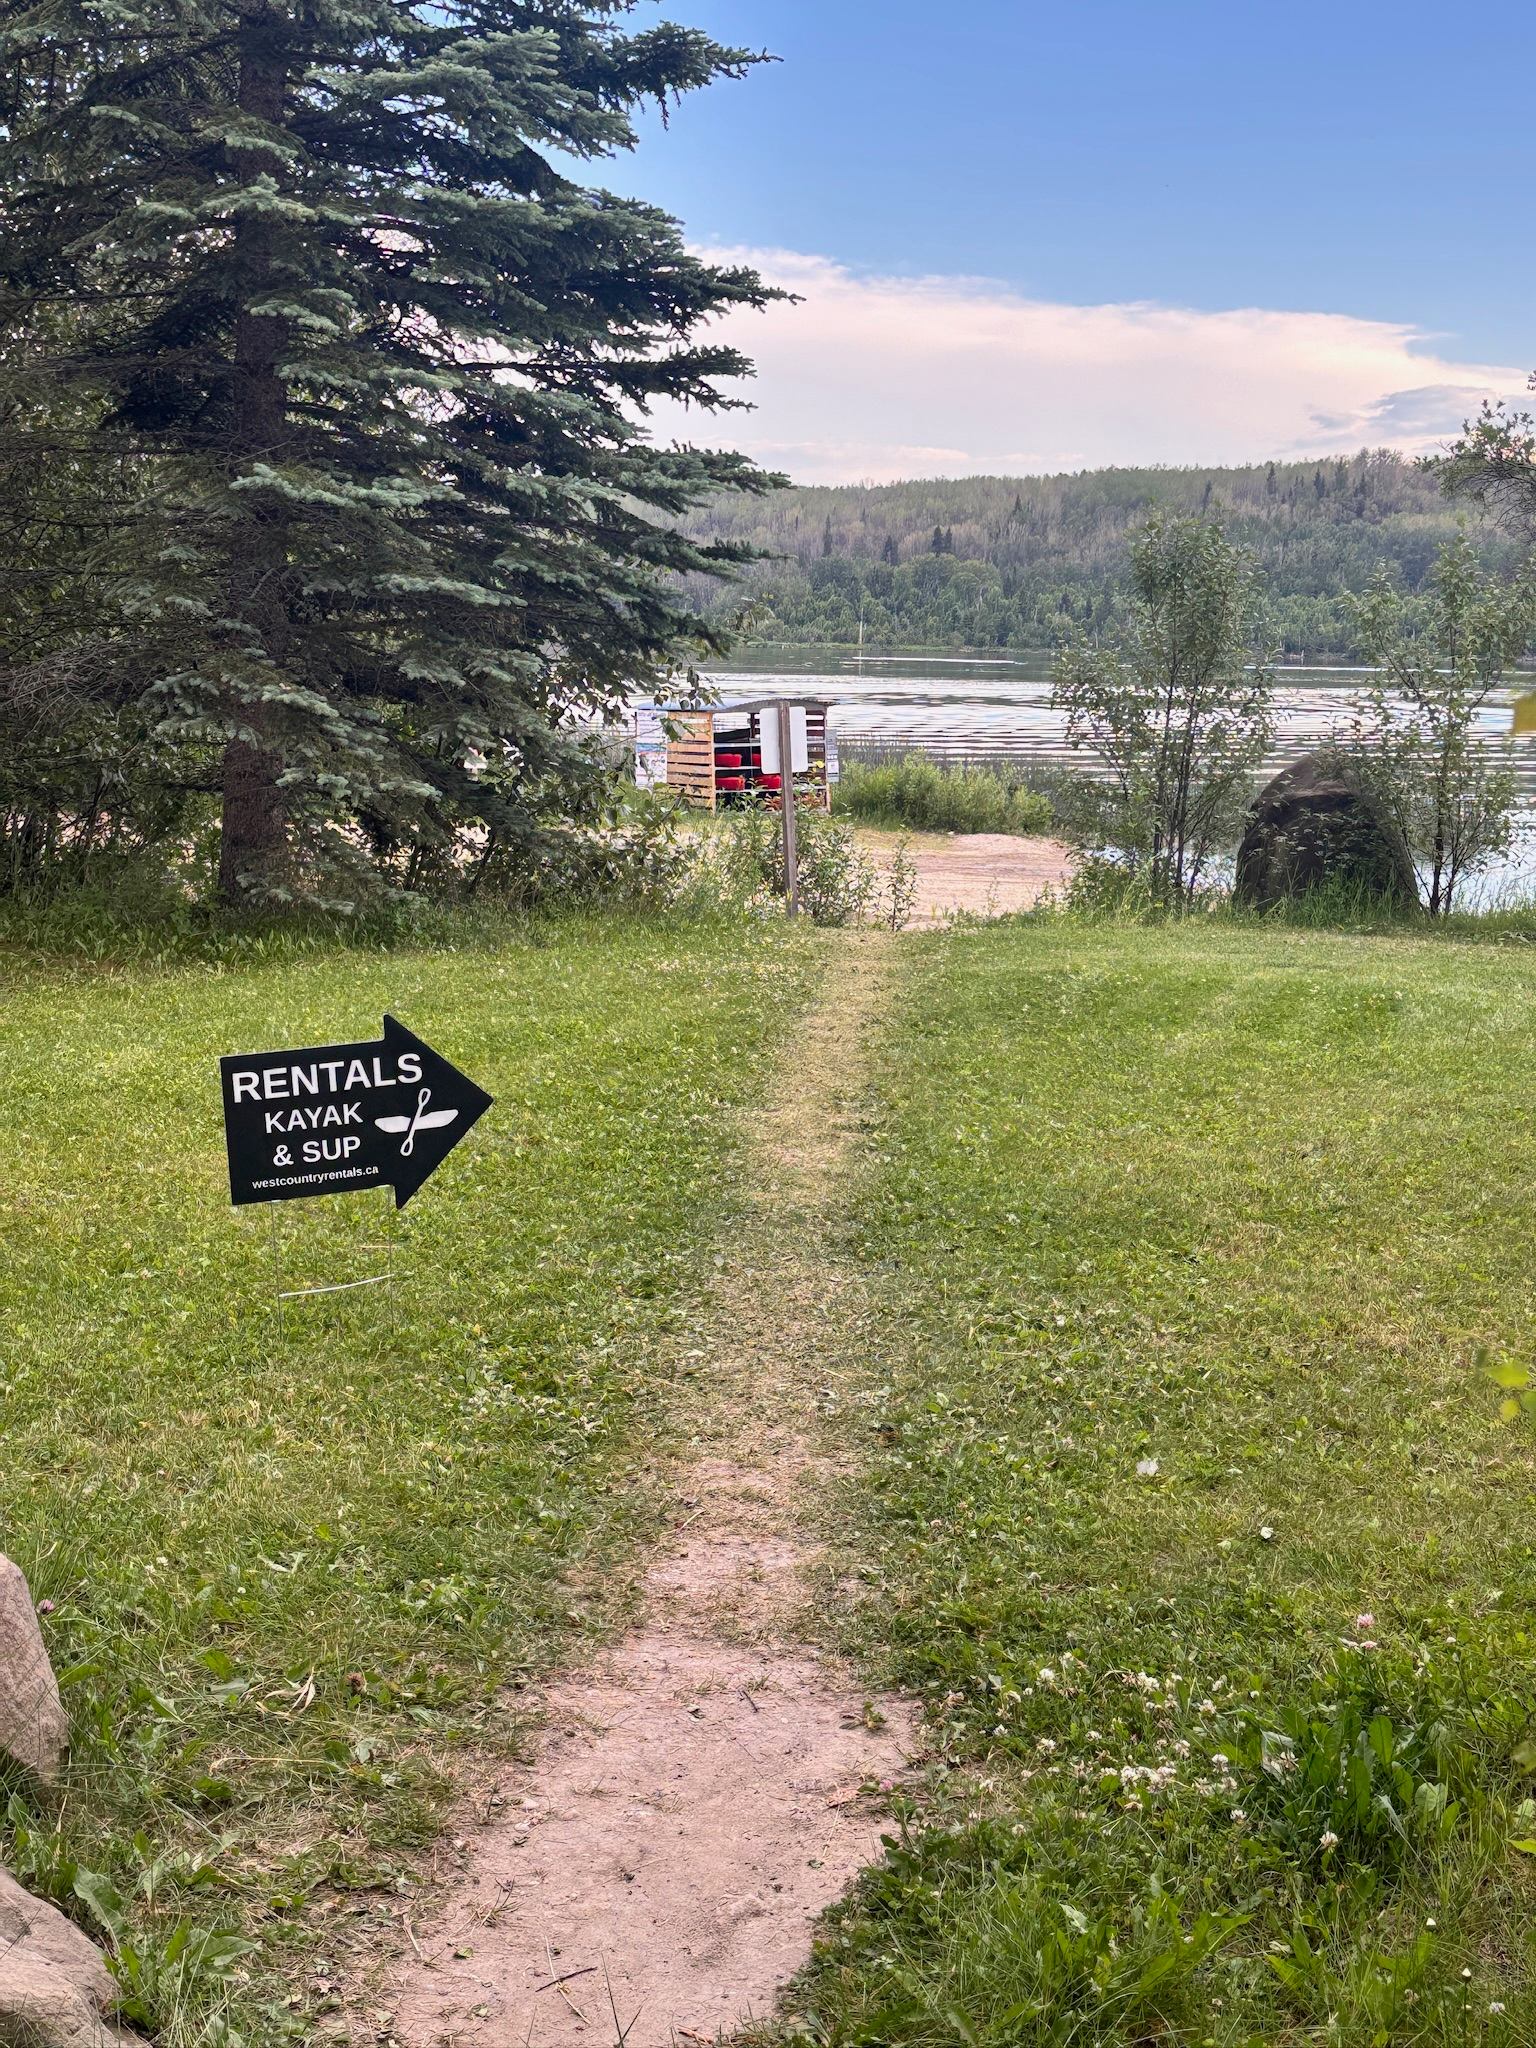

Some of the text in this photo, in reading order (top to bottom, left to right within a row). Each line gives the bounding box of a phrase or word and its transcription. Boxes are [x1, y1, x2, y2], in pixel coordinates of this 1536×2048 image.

[232, 1053, 423, 1103] RENTALS
[265, 1102, 363, 1133] KAYAK
[273, 1136, 361, 1166] & SUP
[252, 1166, 379, 1189] westcountryrentals.ca
